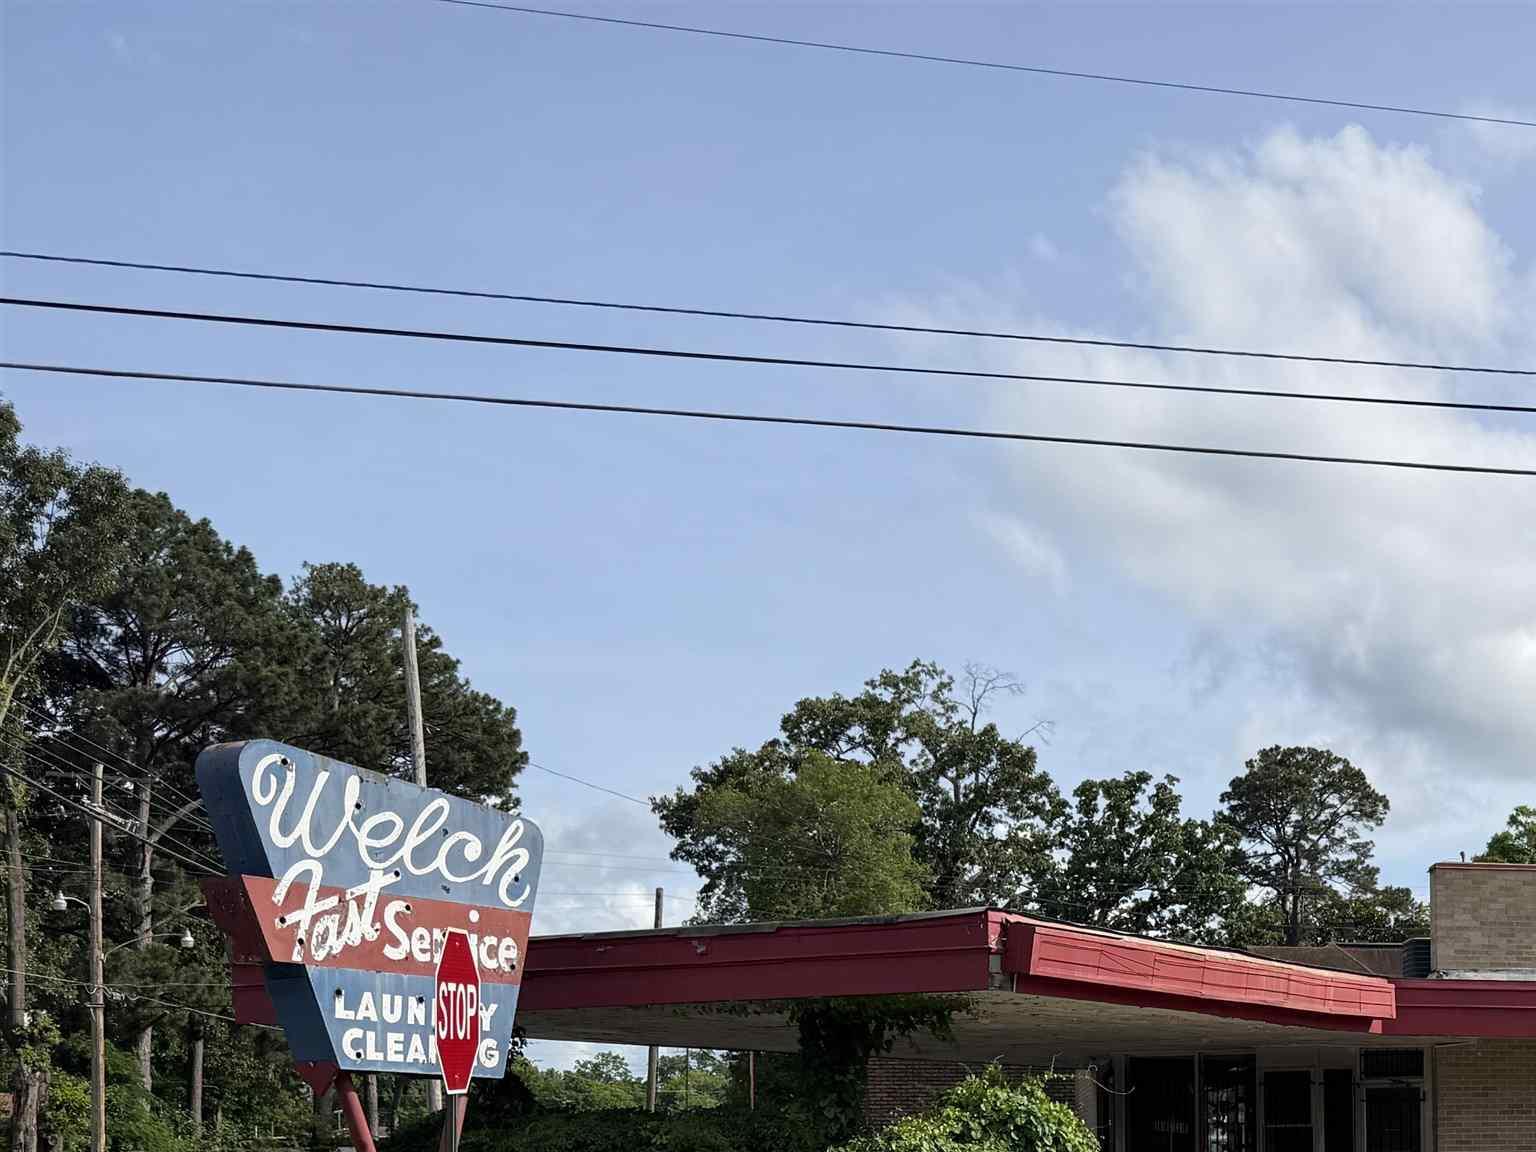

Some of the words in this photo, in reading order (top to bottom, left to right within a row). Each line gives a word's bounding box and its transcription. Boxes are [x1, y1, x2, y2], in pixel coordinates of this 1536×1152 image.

[252, 753, 531, 908] Welch
[272, 859, 401, 962] Fast
[383, 900, 518, 973] Serice
[334, 988, 499, 1032] LAUNY
[438, 981, 478, 1041] STOP
[341, 1027, 500, 1069] CLEAG
